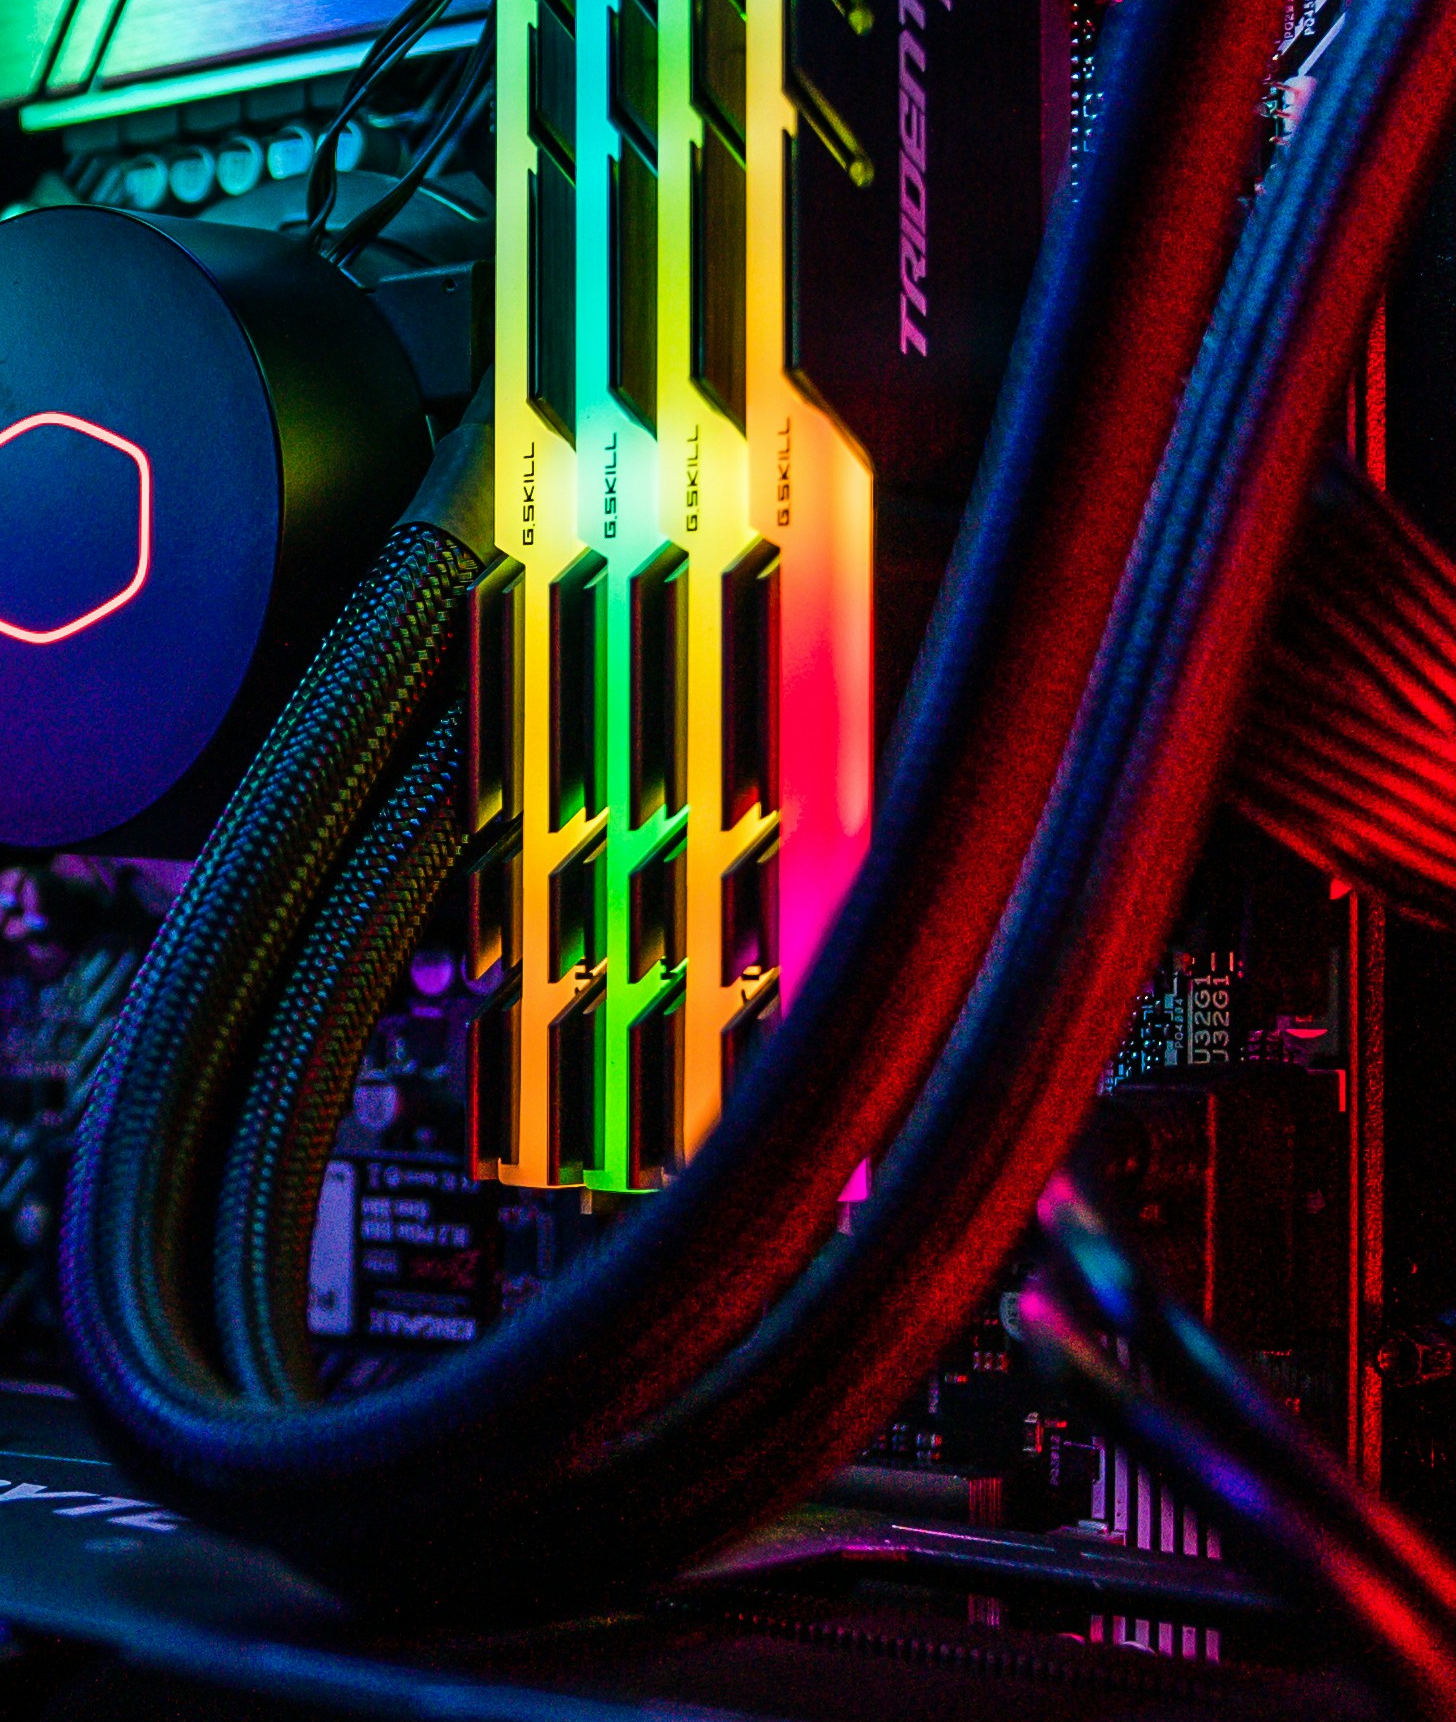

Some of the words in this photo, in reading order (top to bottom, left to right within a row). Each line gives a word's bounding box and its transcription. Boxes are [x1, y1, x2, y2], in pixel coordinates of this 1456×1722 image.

[522, 442, 536, 546] G.SKILL
[604, 432, 618, 539] G.SKILL
[686, 424, 700, 532] G.SKILL
[777, 416, 792, 527] G.SKILL
